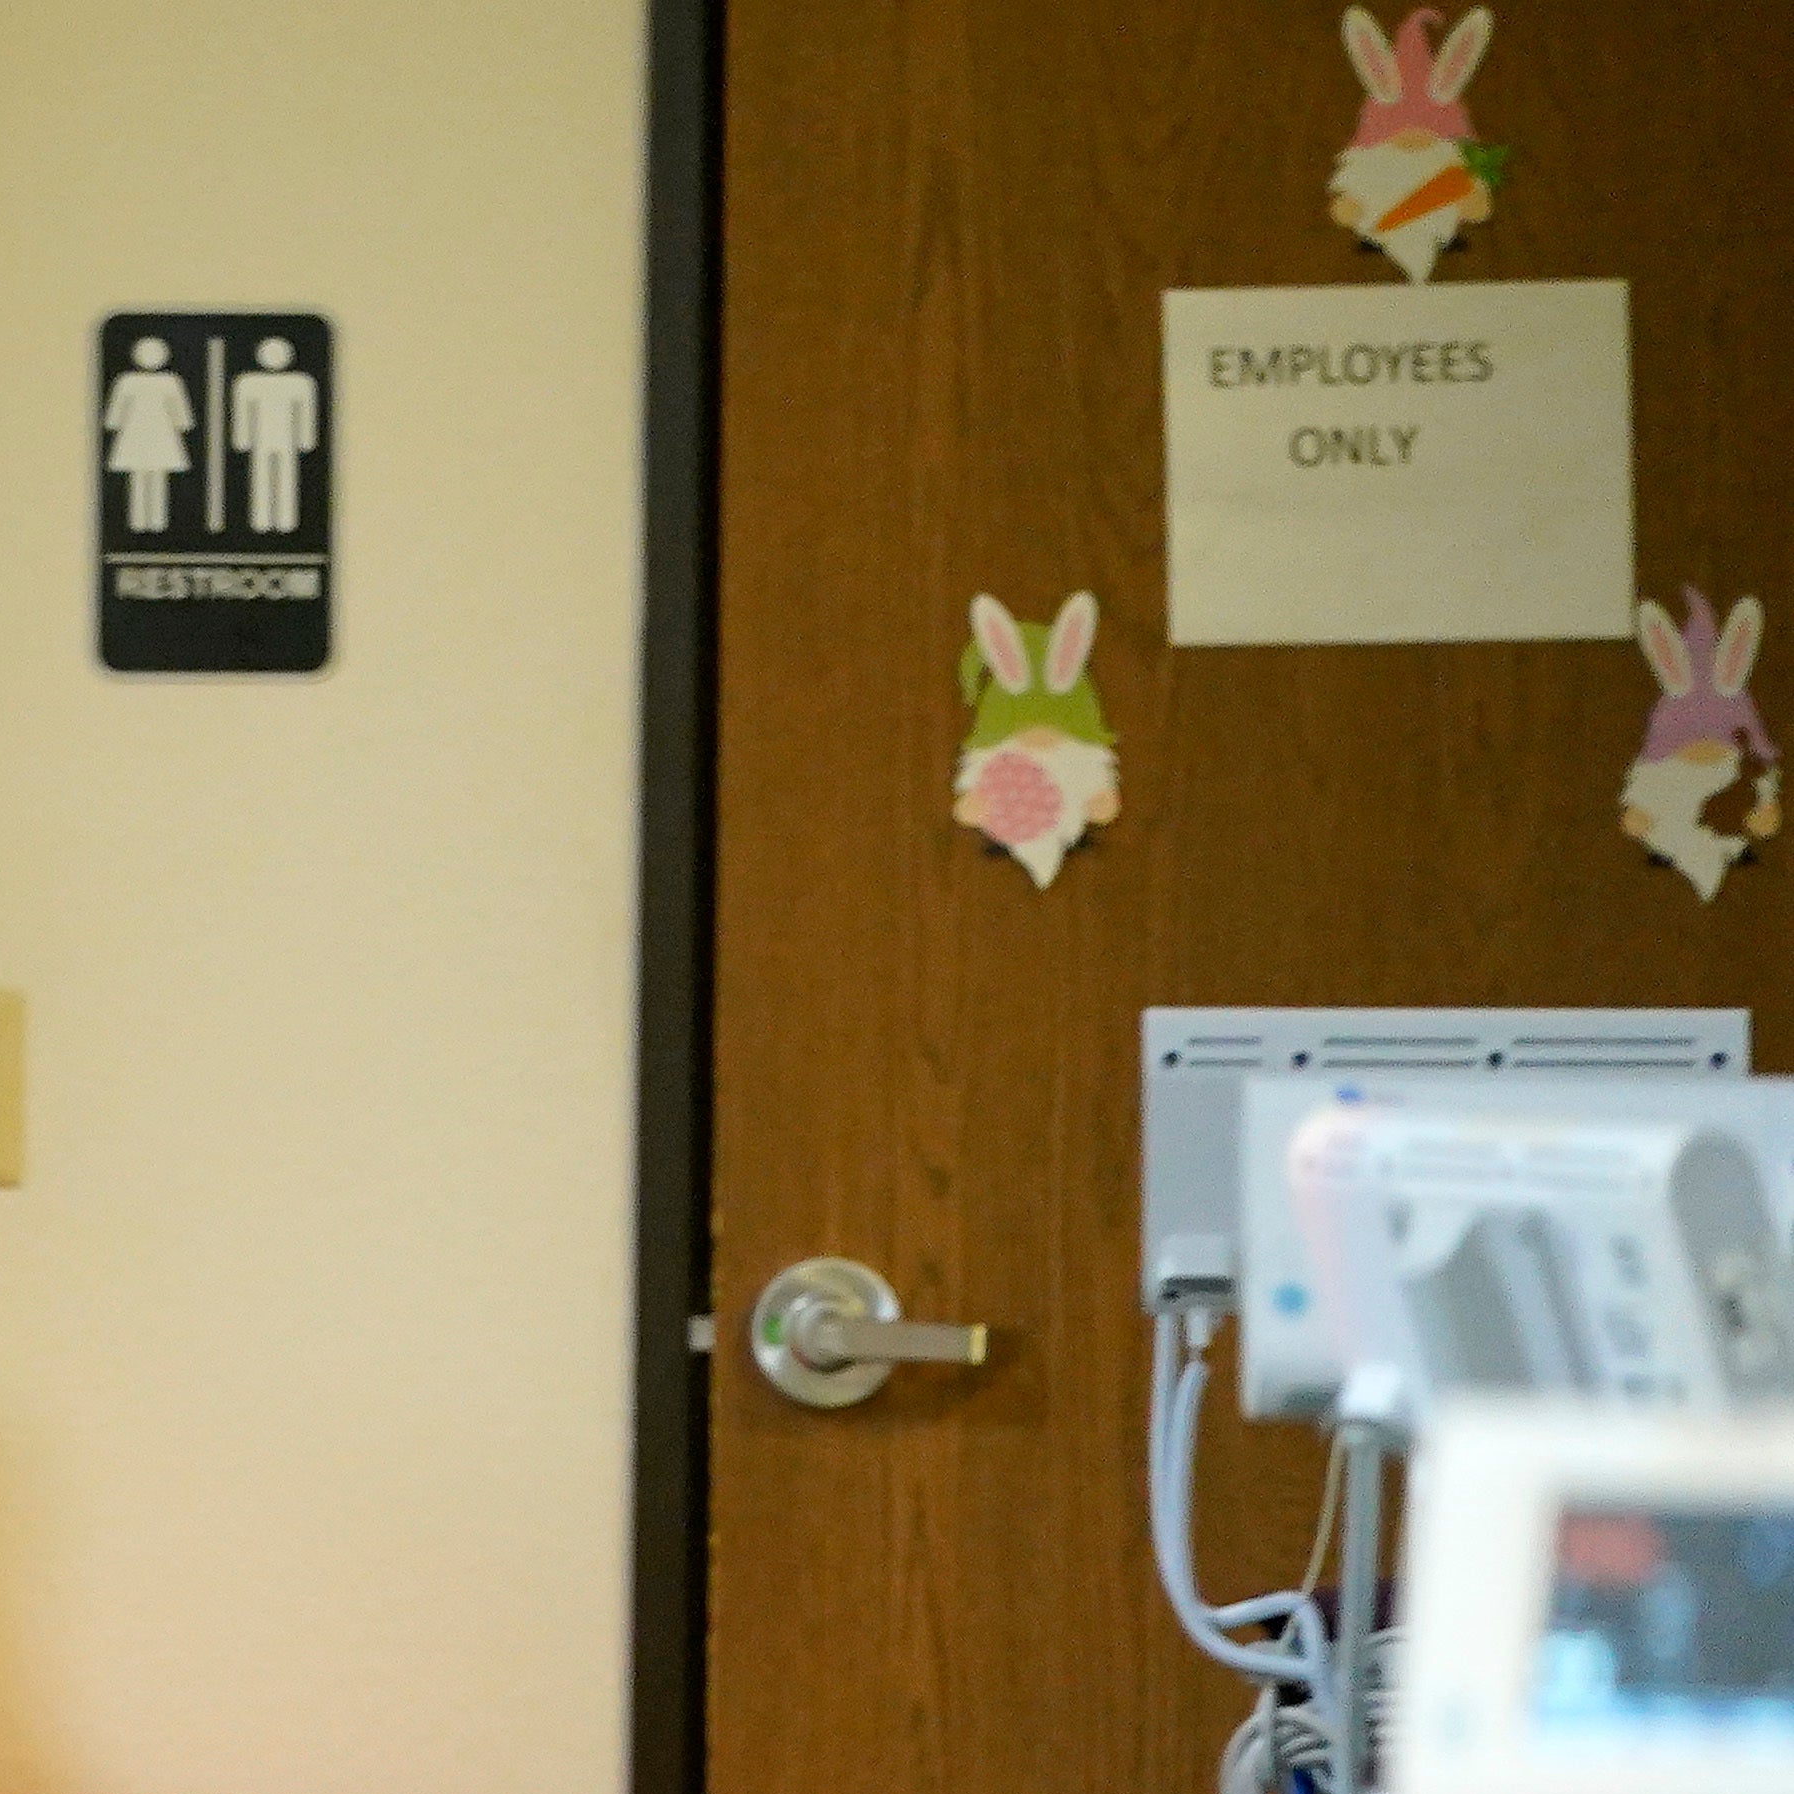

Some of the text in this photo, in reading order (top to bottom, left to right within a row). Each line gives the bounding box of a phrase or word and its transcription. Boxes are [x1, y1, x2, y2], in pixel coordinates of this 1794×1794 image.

[1208, 341, 1494, 389] EMPLOYEES
[1288, 426, 1420, 468] ONLY
[116, 567, 320, 599] RESTROOM
